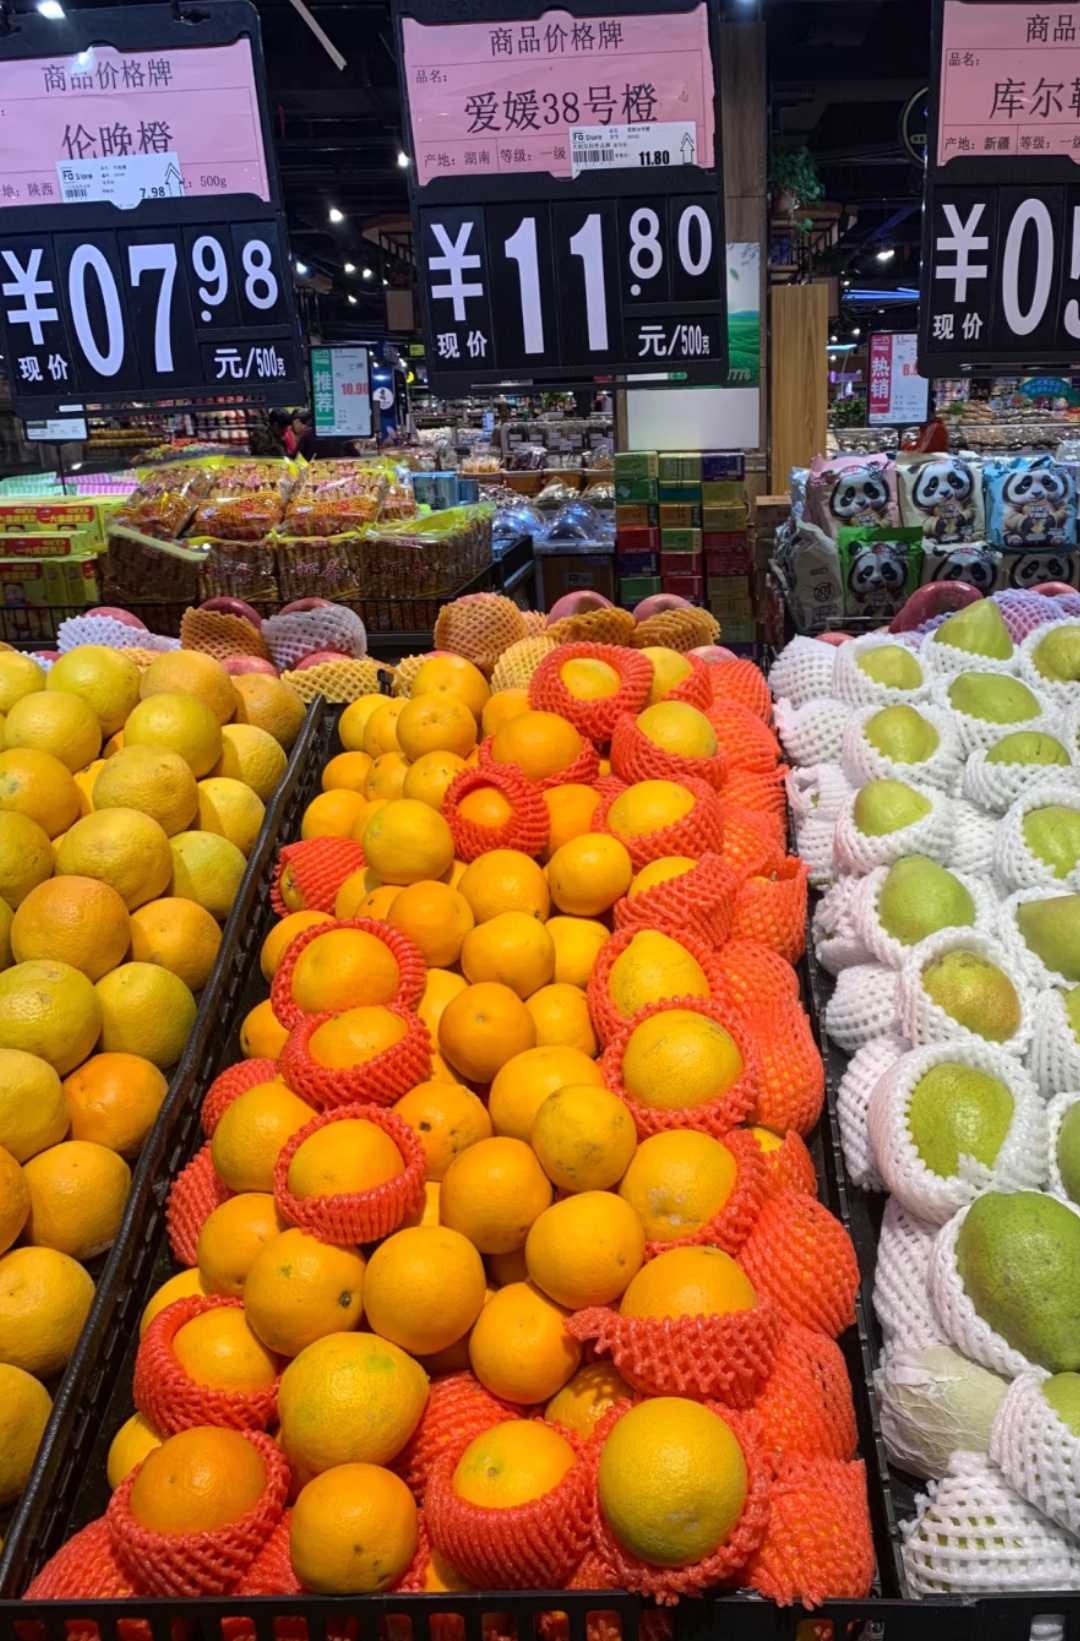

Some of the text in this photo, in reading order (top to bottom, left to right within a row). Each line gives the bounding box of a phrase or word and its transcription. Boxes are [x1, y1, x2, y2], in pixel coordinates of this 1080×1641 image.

[489, 20, 624, 56] 商品价格牌
[1026, 14, 1080, 43] 商品
[42, 57, 173, 92] 商品价格牌
[464, 82, 658, 133] 爱媛38号橙
[62, 120, 174, 160] 伦晚橙
[639, 150, 670, 166] 11.80
[139, 187, 166, 198] 7.98
[638, 324, 710, 357] 元/500克
[932, 312, 983, 340] 现价
[437, 330, 488, 358] 现价
[18, 354, 68, 382] 现价
[214, 346, 286, 379] 元/500克
